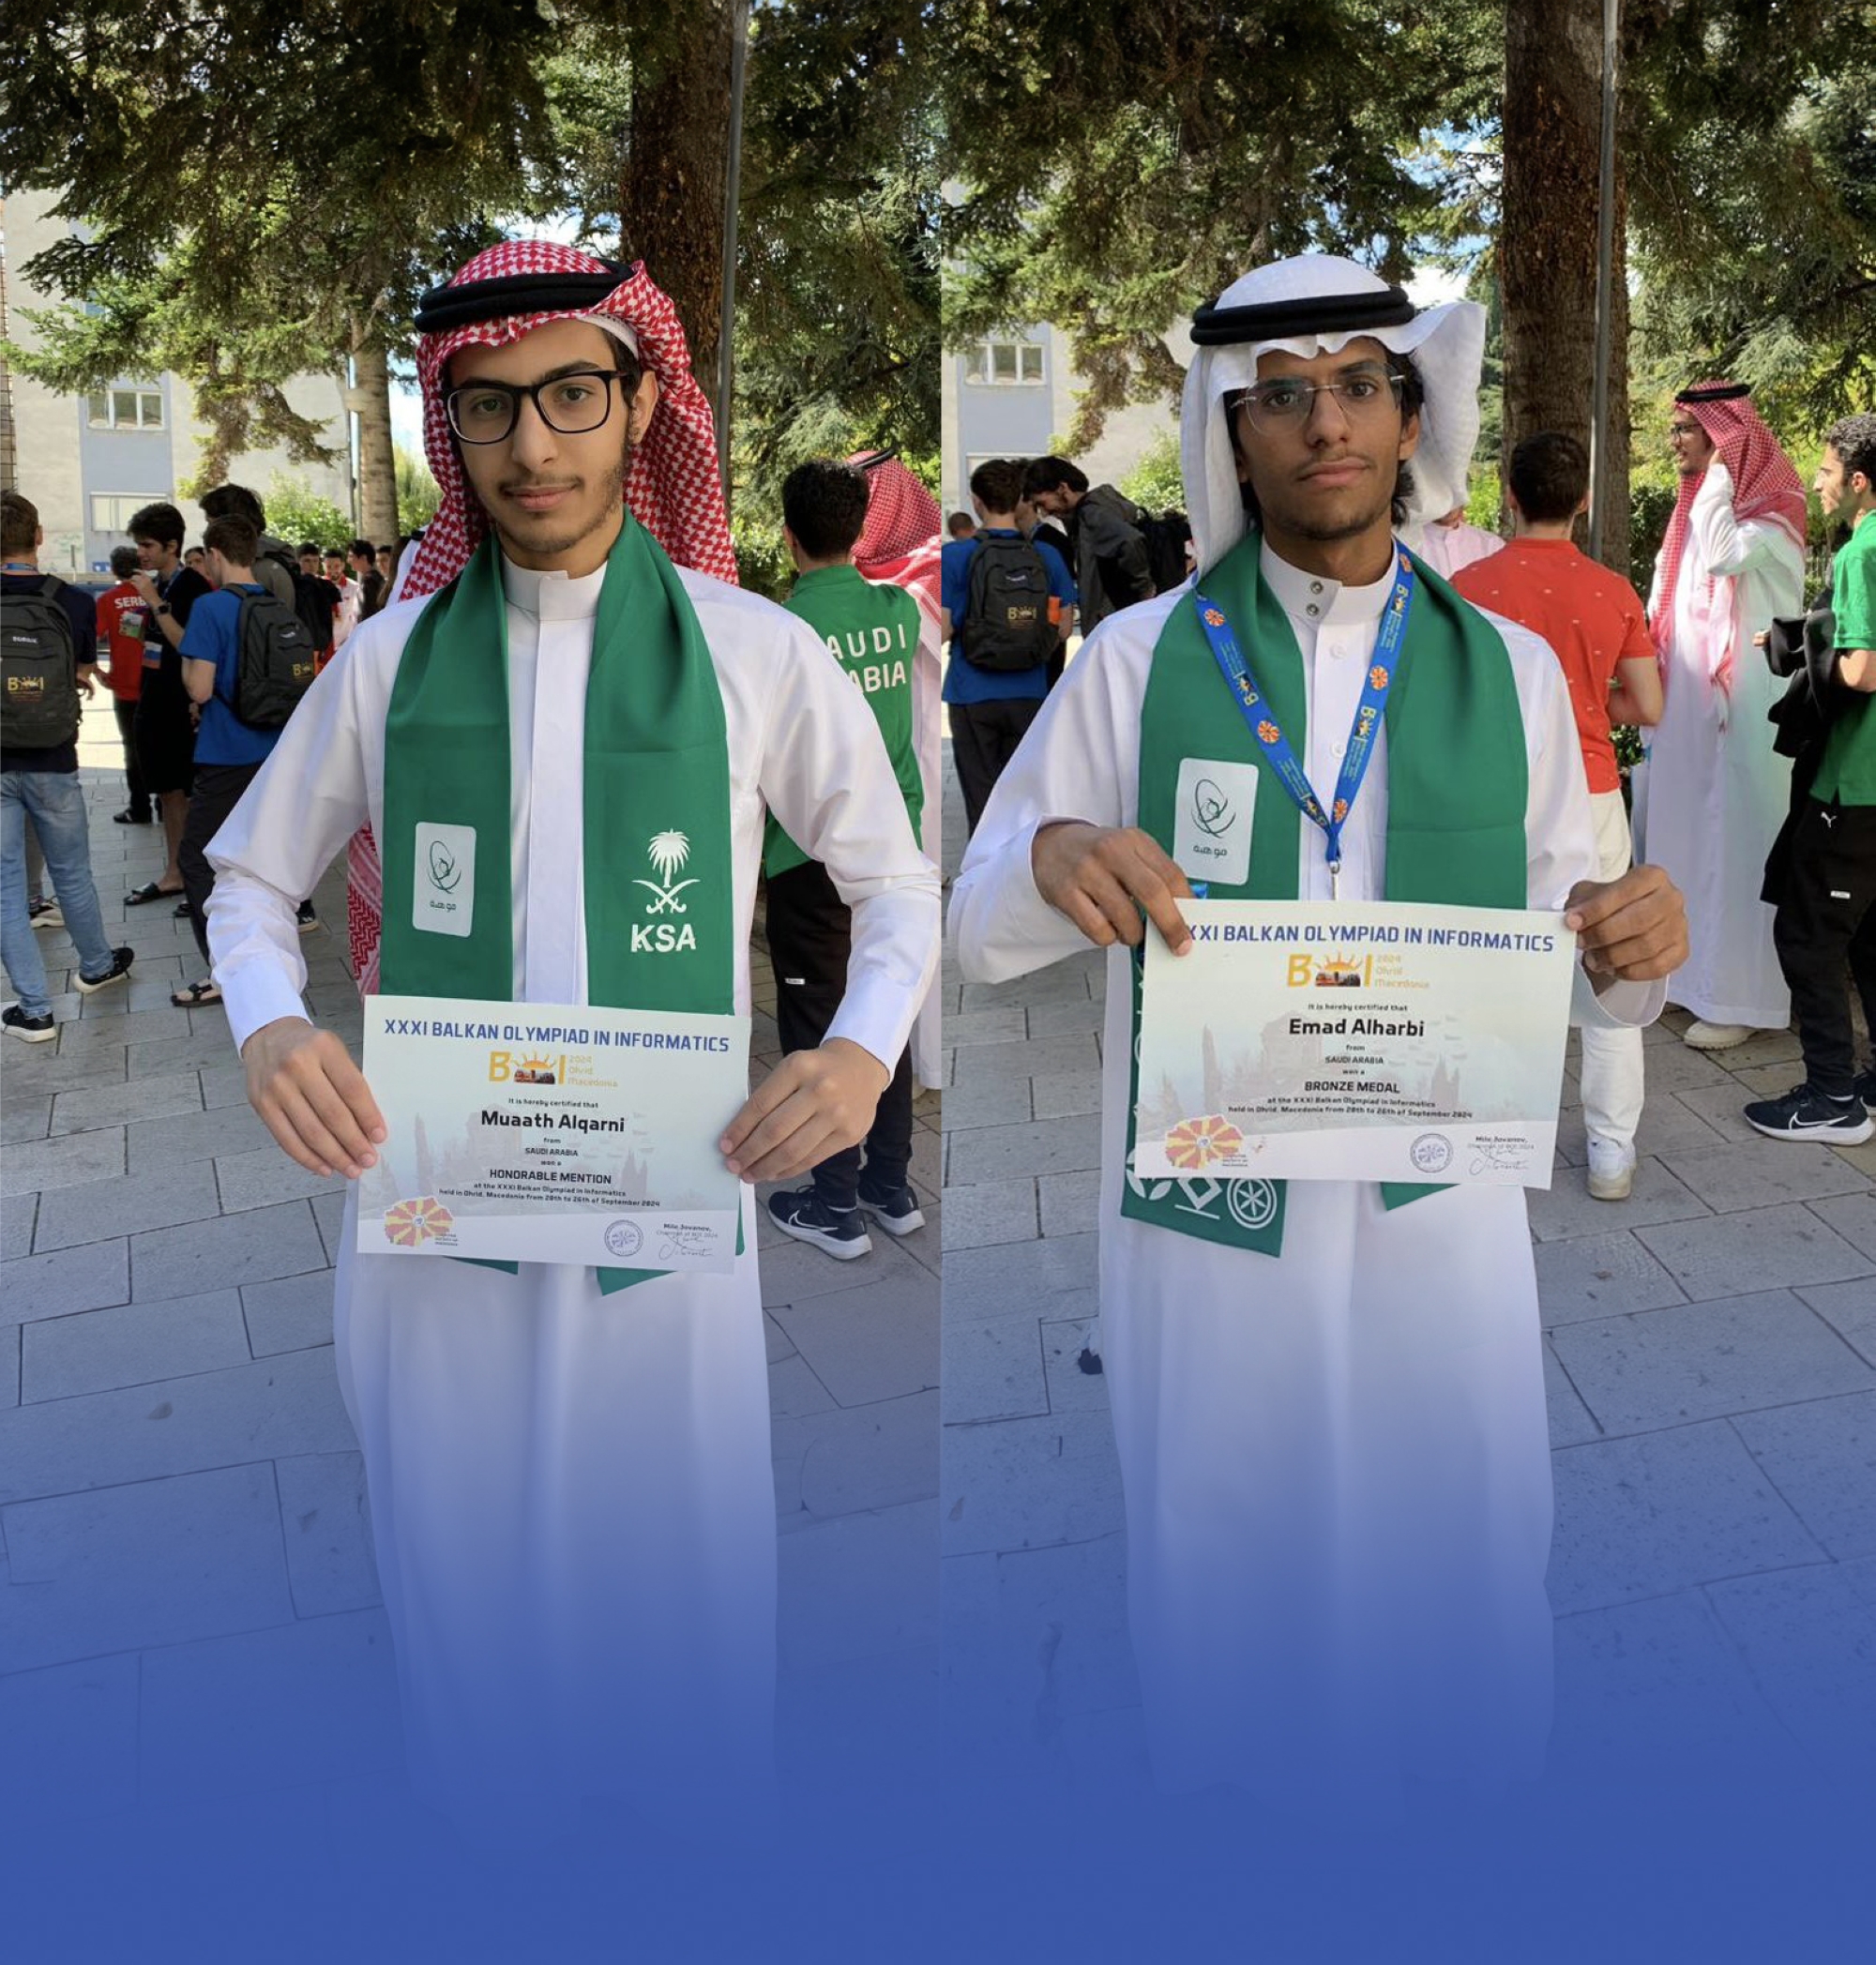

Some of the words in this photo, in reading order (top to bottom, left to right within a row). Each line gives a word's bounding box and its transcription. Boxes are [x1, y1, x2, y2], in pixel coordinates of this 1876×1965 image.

[114, 596, 147, 609] SERB
[826, 624, 907, 660] AUDI
[849, 660, 907, 693] ABIA
[630, 923, 697, 953] KSA
[1189, 925, 1218, 941] XXI
[1223, 925, 1299, 942] BALKAN
[1305, 925, 1399, 943] OLYMPIAD
[1404, 927, 1422, 944] IN
[1428, 929, 1553, 952] INFORMATICS
[1324, 1004, 1353, 1012] hereby
[1289, 1019, 1347, 1035] Emad
[1351, 1019, 1425, 1036] Alharbi
[385, 1019, 427, 1035] XXXI
[431, 1021, 498, 1040] BALKAN
[504, 1025, 589, 1045] OLYMPIAD
[594, 1030, 610, 1046] IN
[614, 1032, 730, 1052] INFORMATICS
[1351, 1056, 1384, 1065] ARABIA
[1304, 1081, 1354, 1092] BRONZE
[1356, 1081, 1400, 1094] MEDAL
[523, 1098, 549, 1107] hereby
[550, 1099, 582, 1108] certified
[1343, 1096, 1379, 1105] Olympiad
[1389, 1098, 1436, 1107] Informatics
[1407, 1109, 1450, 1118] September
[481, 1110, 554, 1128] Muaath
[558, 1114, 625, 1134] Alqarni
[525, 1147, 549, 1156] SAUDI
[549, 1148, 579, 1156] ARABIA
[490, 1169, 557, 1181] HONORABLE
[559, 1172, 612, 1185] MENTION
[486, 1191, 524, 1200] Macedonia
[600, 1198, 640, 1206] September
[542, 1186, 575, 1194] Olympiad
[583, 1188, 627, 1197] Informatics
